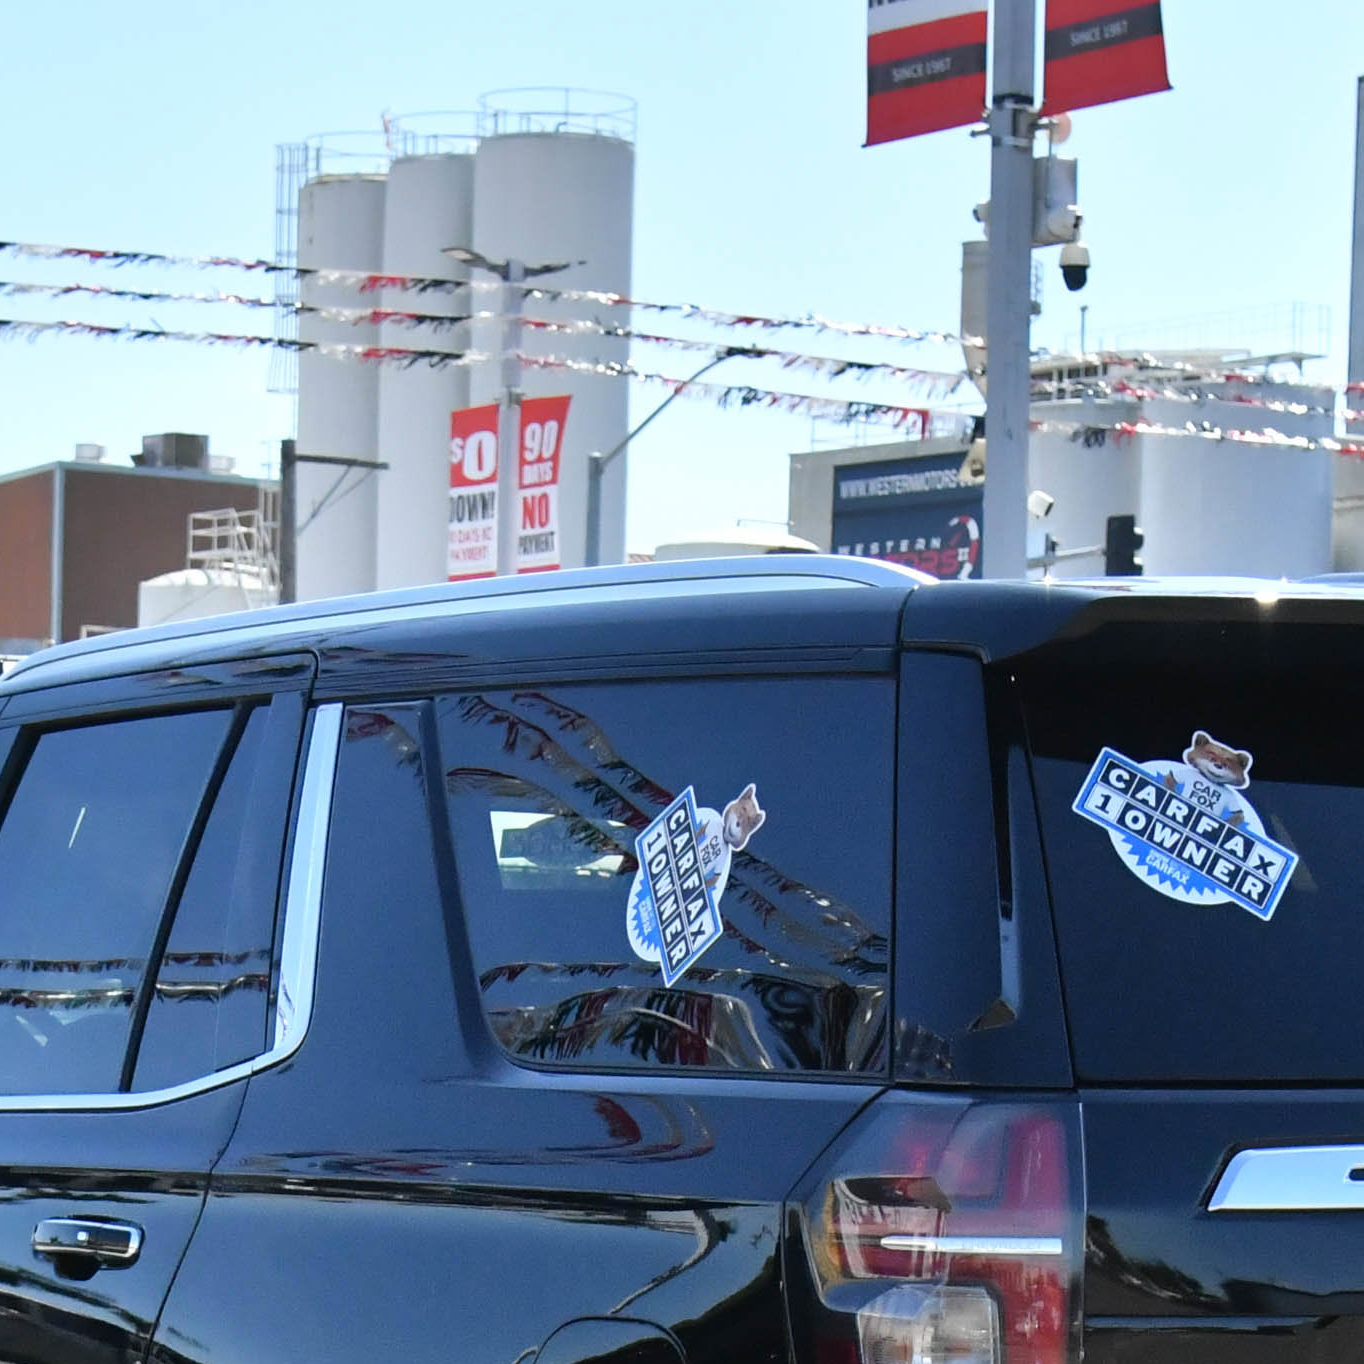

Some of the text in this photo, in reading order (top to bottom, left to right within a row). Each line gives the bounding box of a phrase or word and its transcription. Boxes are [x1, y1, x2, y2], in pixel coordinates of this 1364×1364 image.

[1070, 26, 1101, 47] SINCE
[892, 63, 925, 83] SINCE
[450, 430, 498, 480] $0
[524, 420, 559, 462] 90
[522, 492, 550, 530] NO
[838, 537, 941, 556] WESTERN
[1188, 790, 1218, 812] FOX
[1192, 780, 1221, 802] CAR
[1107, 768, 1276, 877] CARFAX
[669, 808, 706, 948] CARFAX
